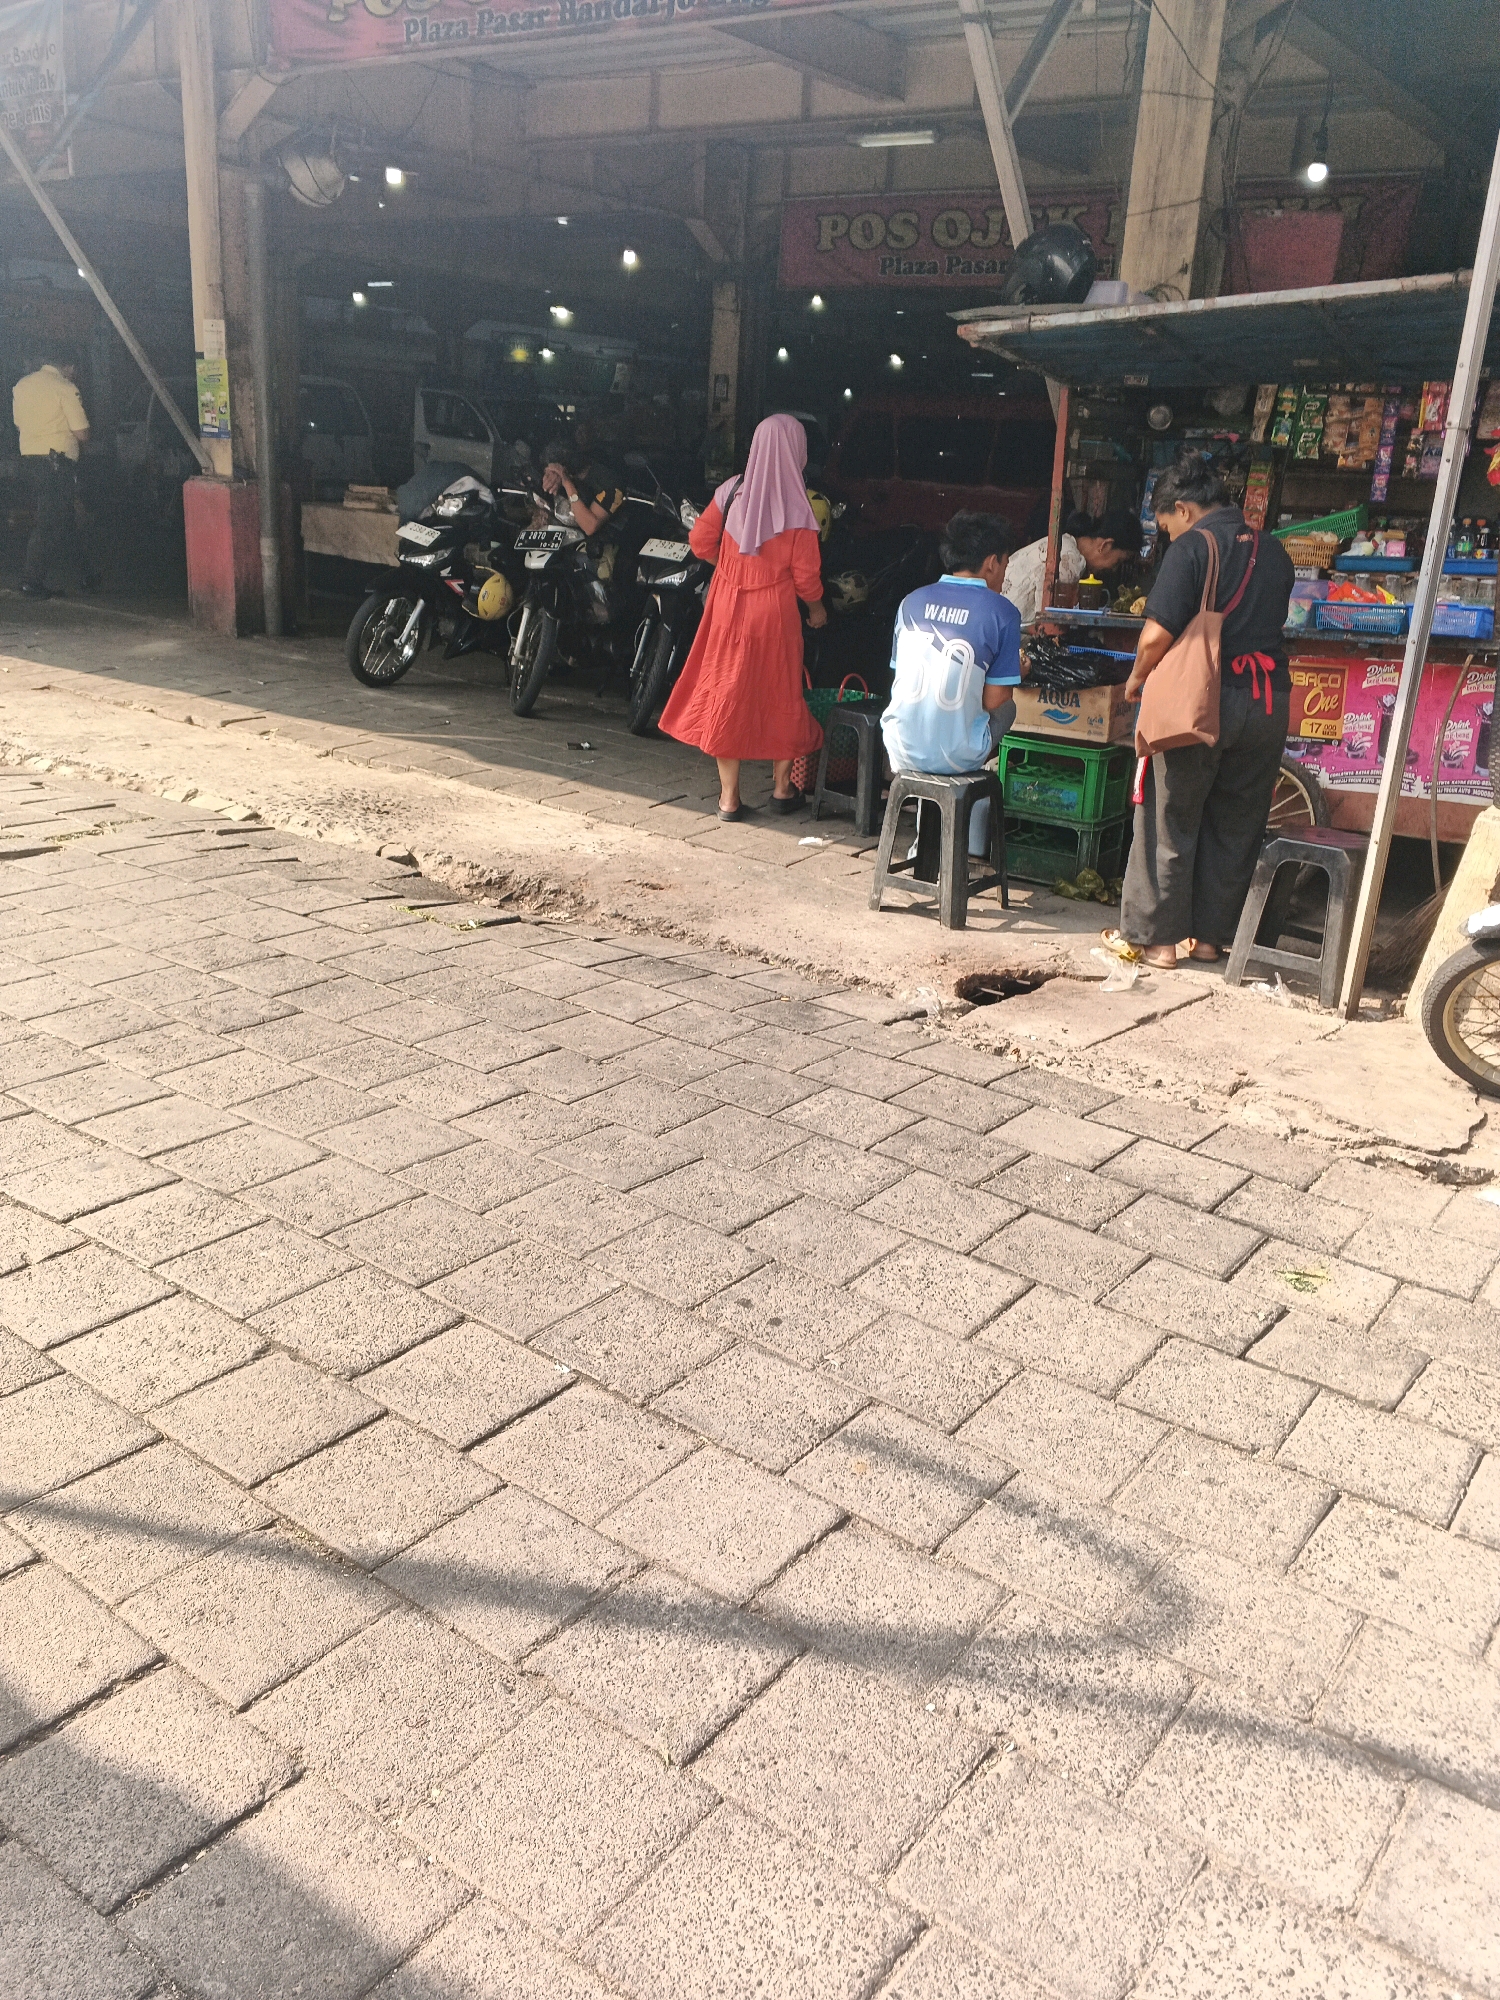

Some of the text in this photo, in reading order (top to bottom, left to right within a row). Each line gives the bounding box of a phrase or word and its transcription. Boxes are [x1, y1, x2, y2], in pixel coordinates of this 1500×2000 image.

[404, 16, 470, 45] Plaza
[477, 6, 550, 37] Pasar
[816, 211, 920, 250] POS
[931, 205, 1088, 249] OJK
[879, 254, 1008, 276] Plaza Pasar
[924, 603, 969, 625] WAHID
[1367, 664, 1396, 678] Drink
[1037, 686, 1081, 708] AQUA
[1303, 687, 1339, 716] One
[1344, 712, 1372, 725] Drink
